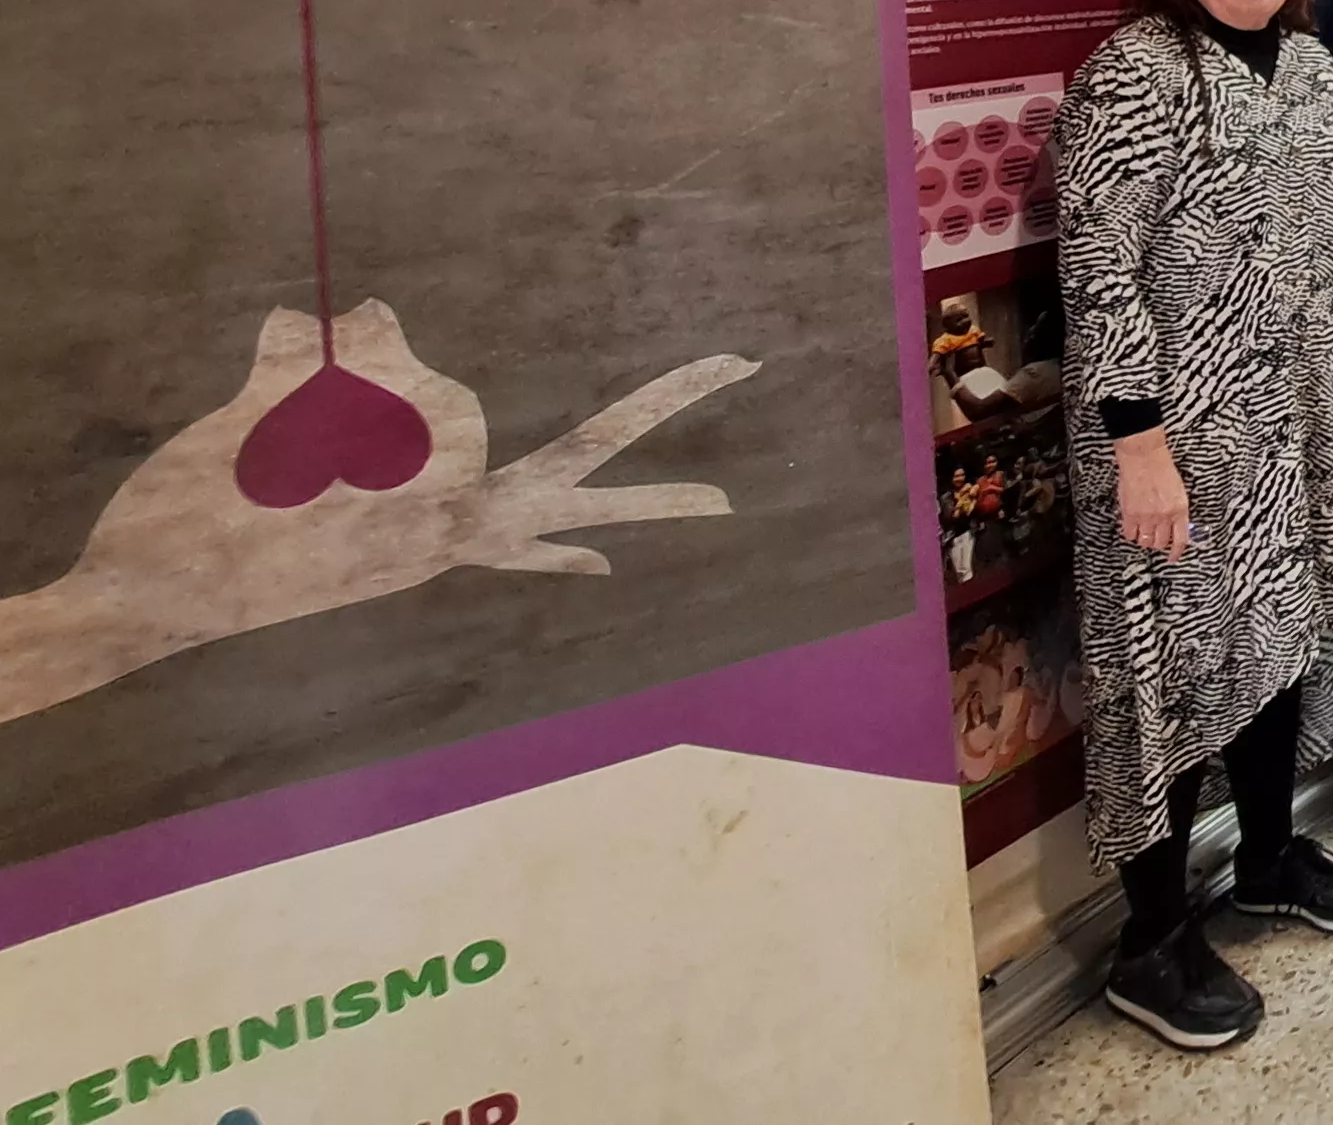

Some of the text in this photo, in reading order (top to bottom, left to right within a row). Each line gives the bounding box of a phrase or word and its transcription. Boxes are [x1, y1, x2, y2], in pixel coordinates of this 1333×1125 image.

[946, 86, 986, 102] derechos
[987, 82, 1026, 96] sexuales
[5, 938, 507, 1125] FEMINISMO
